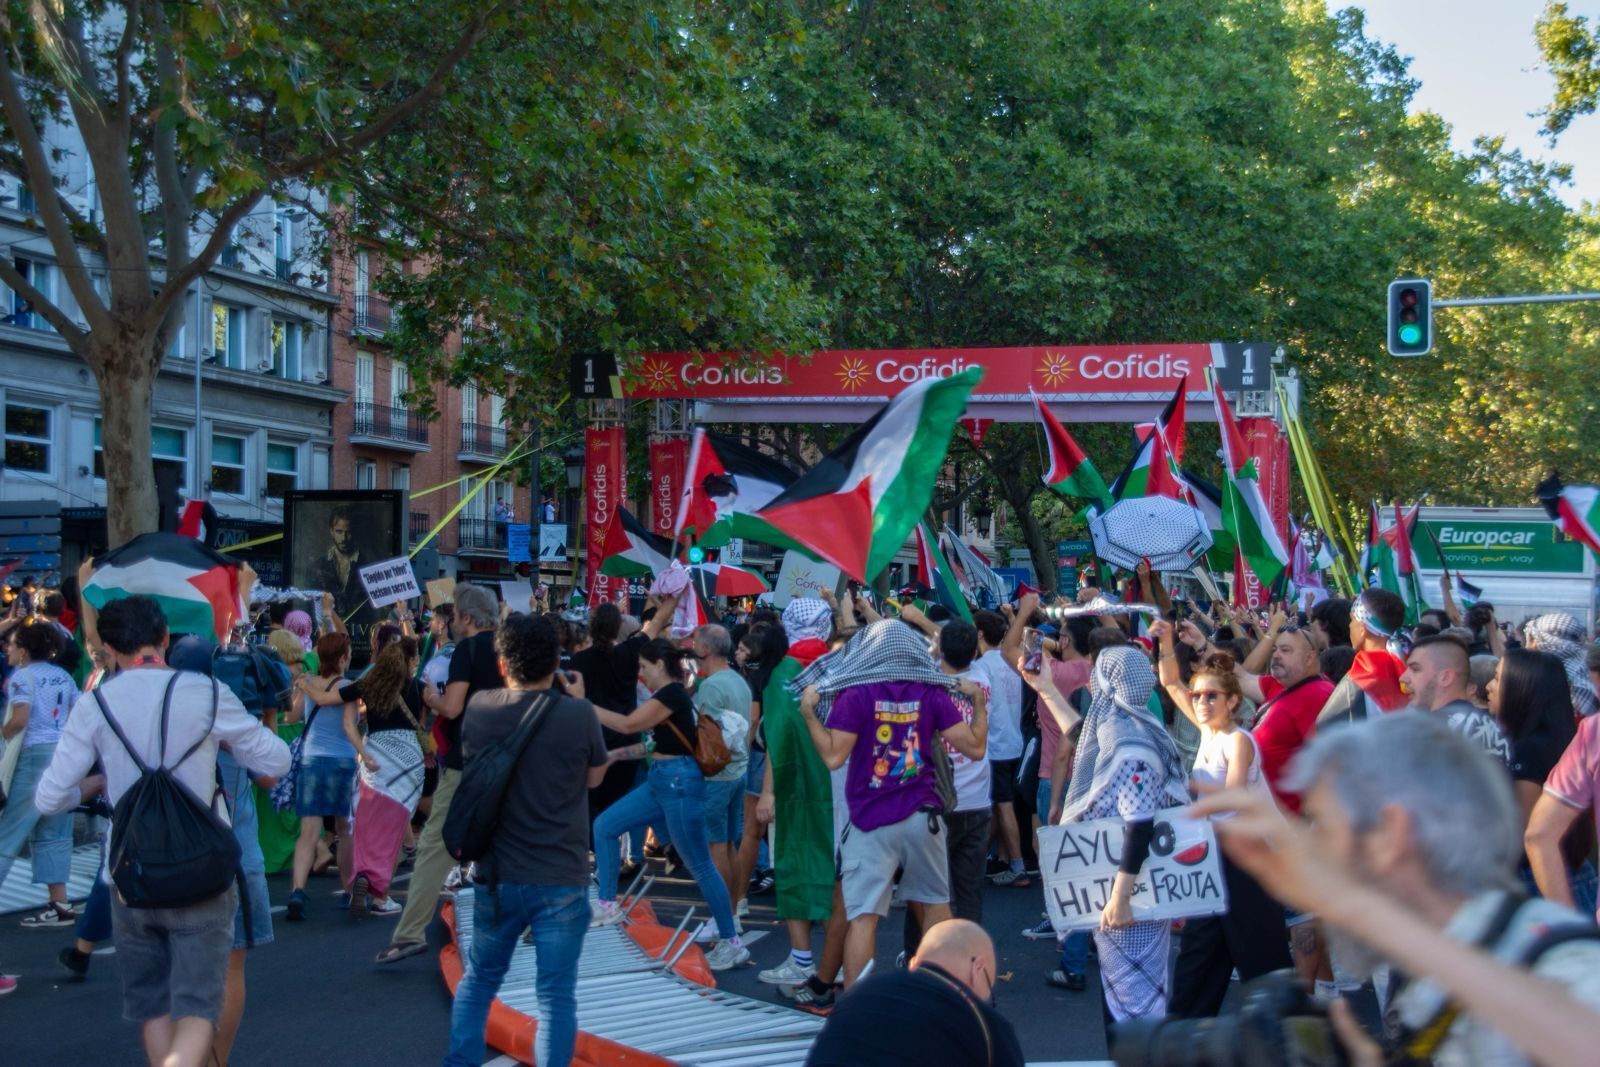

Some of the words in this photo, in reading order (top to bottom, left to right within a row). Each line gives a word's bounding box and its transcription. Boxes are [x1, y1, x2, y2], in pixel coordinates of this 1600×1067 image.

[584, 359, 595, 383] 1
[1079, 353, 1190, 379] Cofidis
[1242, 348, 1254, 374] 1
[584, 384, 595, 393] KM
[1242, 375, 1253, 385] KM
[593, 463, 608, 524] Cofidis
[659, 474, 672, 530] Cofidis
[1438, 527, 1536, 549] Europcar
[1509, 555, 1534, 564] way
[1053, 877, 1117, 917] HIJ
[1149, 866, 1220, 905] FRUTA
